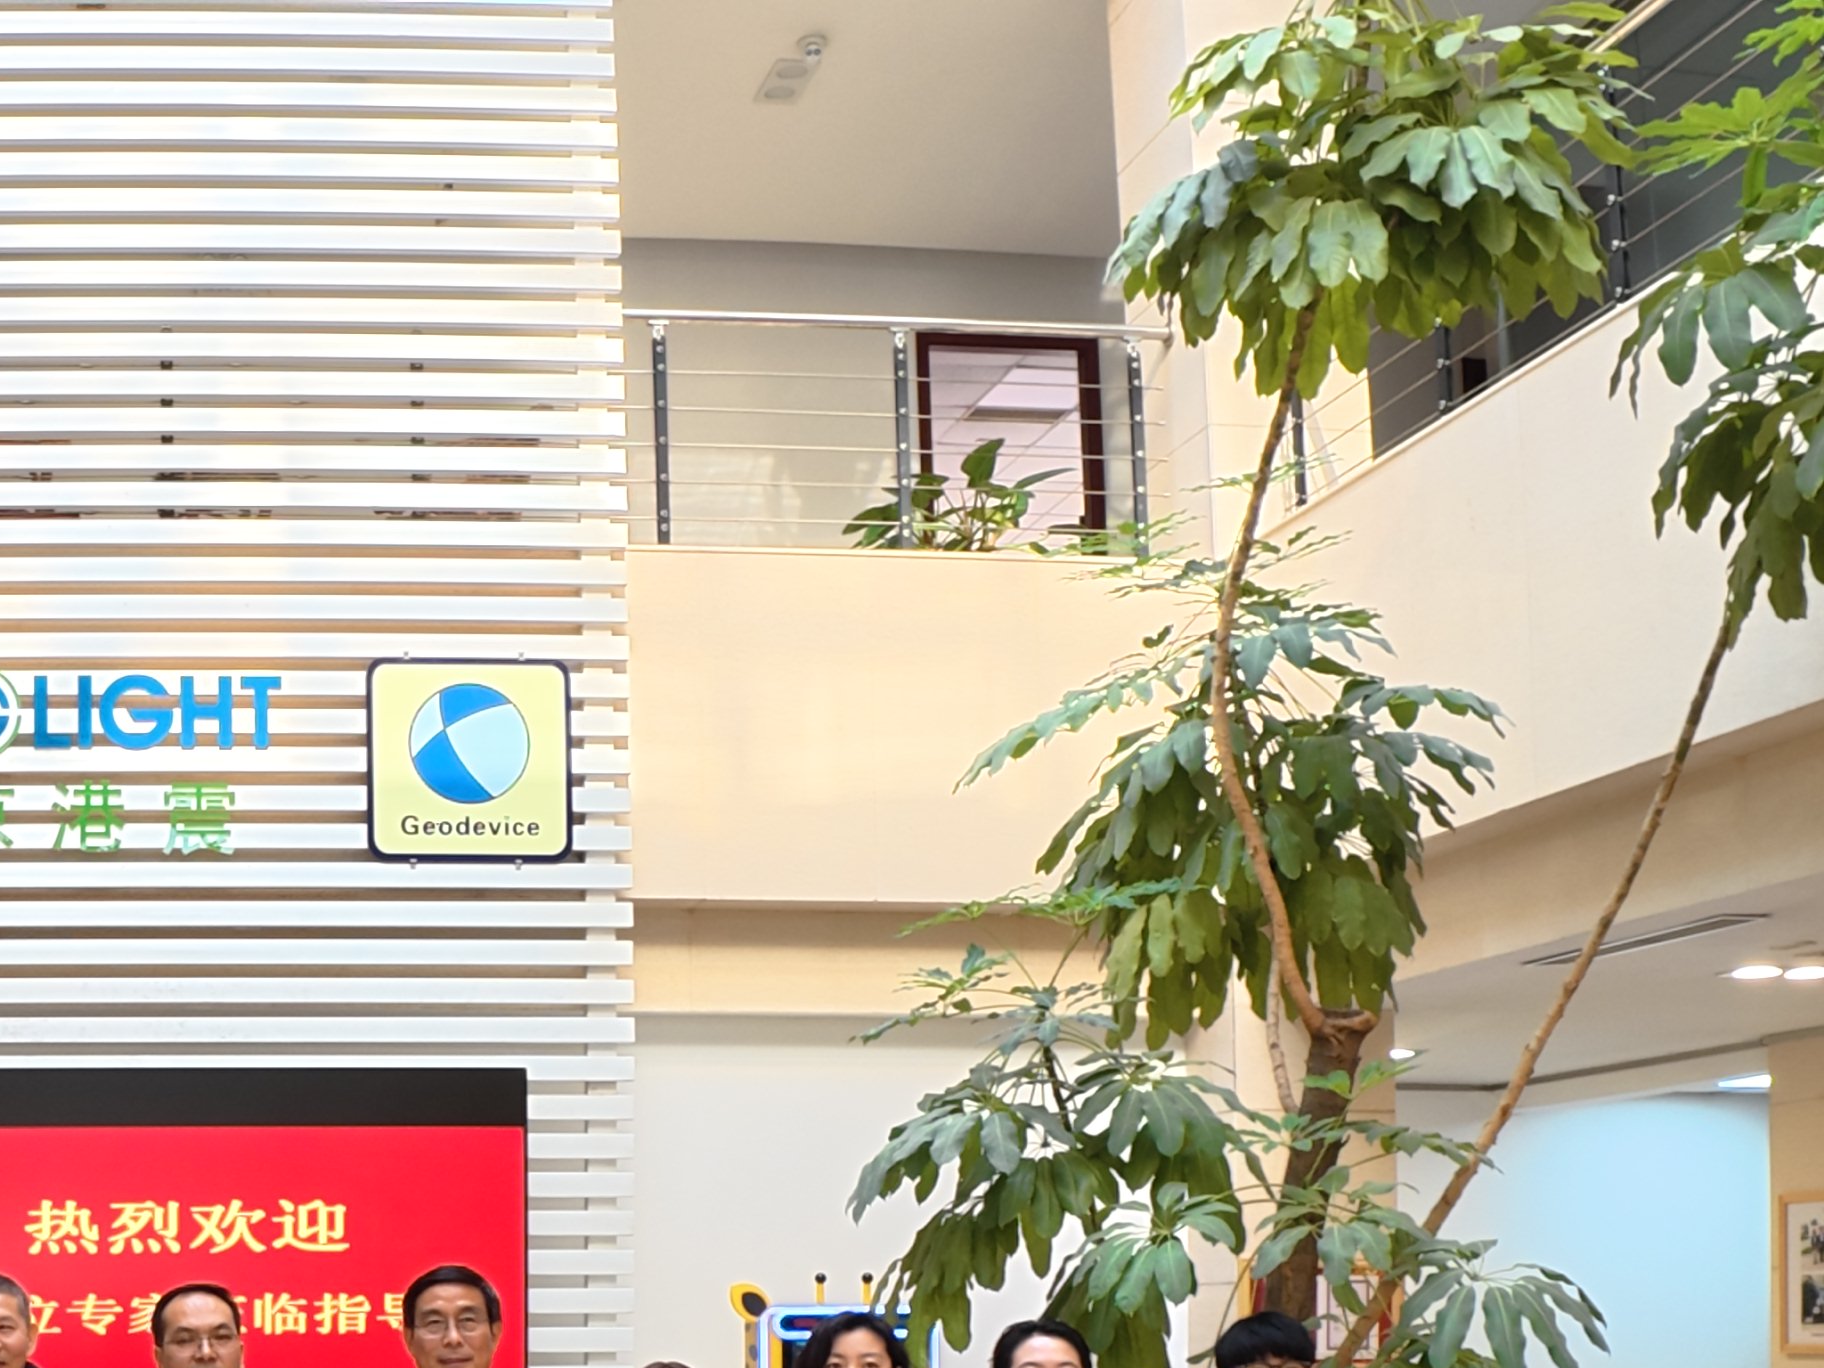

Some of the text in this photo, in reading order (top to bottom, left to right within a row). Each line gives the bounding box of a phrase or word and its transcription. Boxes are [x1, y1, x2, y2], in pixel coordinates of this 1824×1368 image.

[400, 814, 540, 837] Geodevice
[24, 1199, 350, 1255] 热烈欢迎
